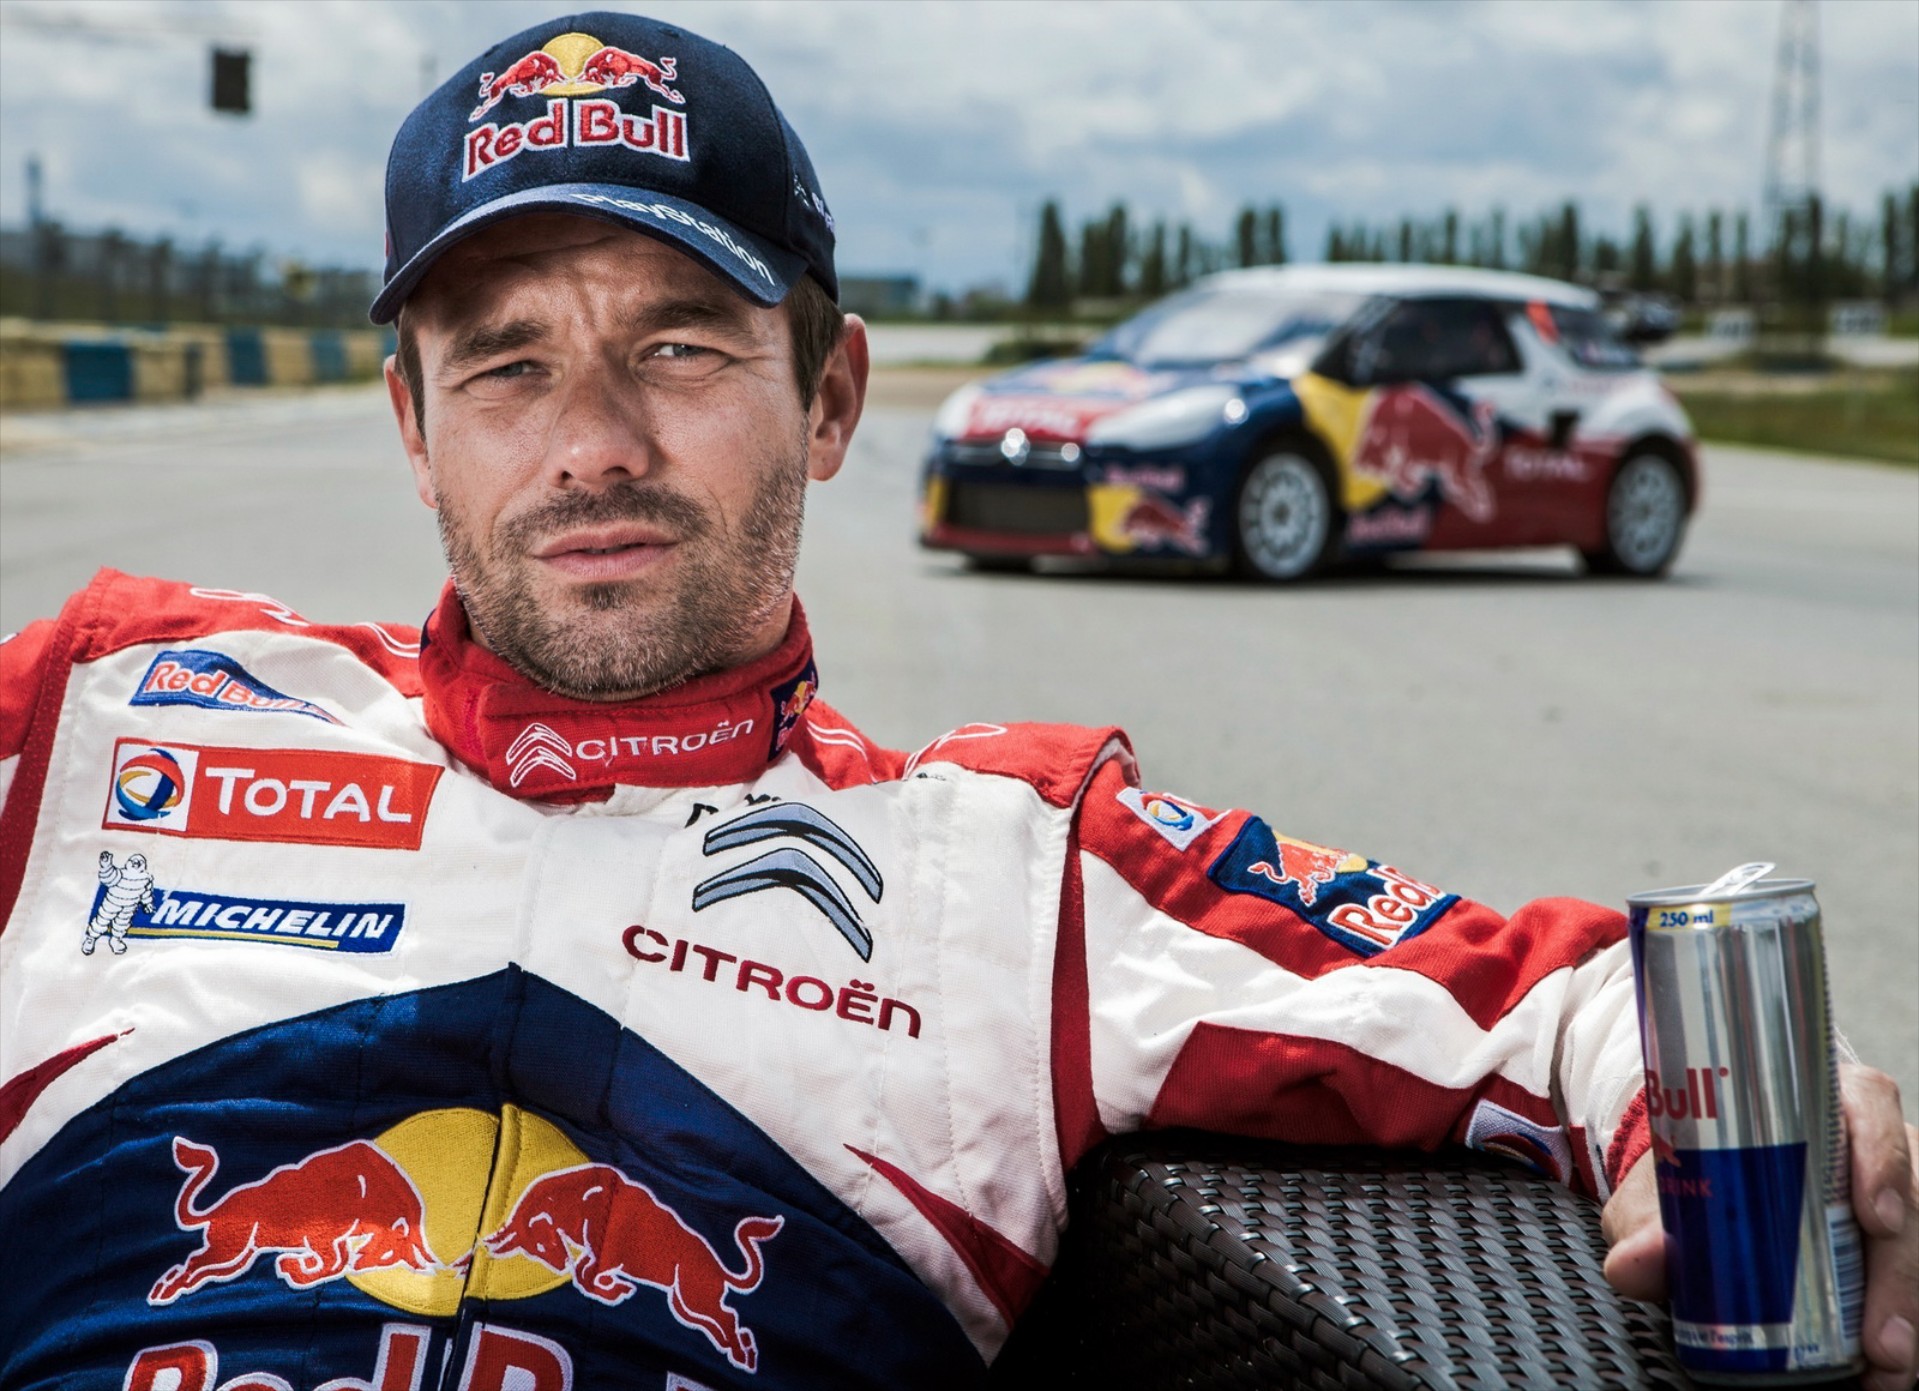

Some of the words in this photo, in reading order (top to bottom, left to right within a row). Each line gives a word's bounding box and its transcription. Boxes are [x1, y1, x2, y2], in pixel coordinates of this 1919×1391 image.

[462, 99, 568, 181] Red
[573, 100, 690, 161] Bull
[144, 661, 228, 698] Red
[217, 679, 308, 710] Bull
[576, 720, 754, 761] CITROËN
[206, 767, 412, 824] TOTAL
[151, 898, 394, 938] MICHELIN
[1327, 869, 1436, 949] Red
[1660, 910, 1689, 927] 250
[1693, 909, 1714, 925] ml
[621, 924, 922, 1039] CITROËN
[1645, 1067, 1718, 1120] Bull
